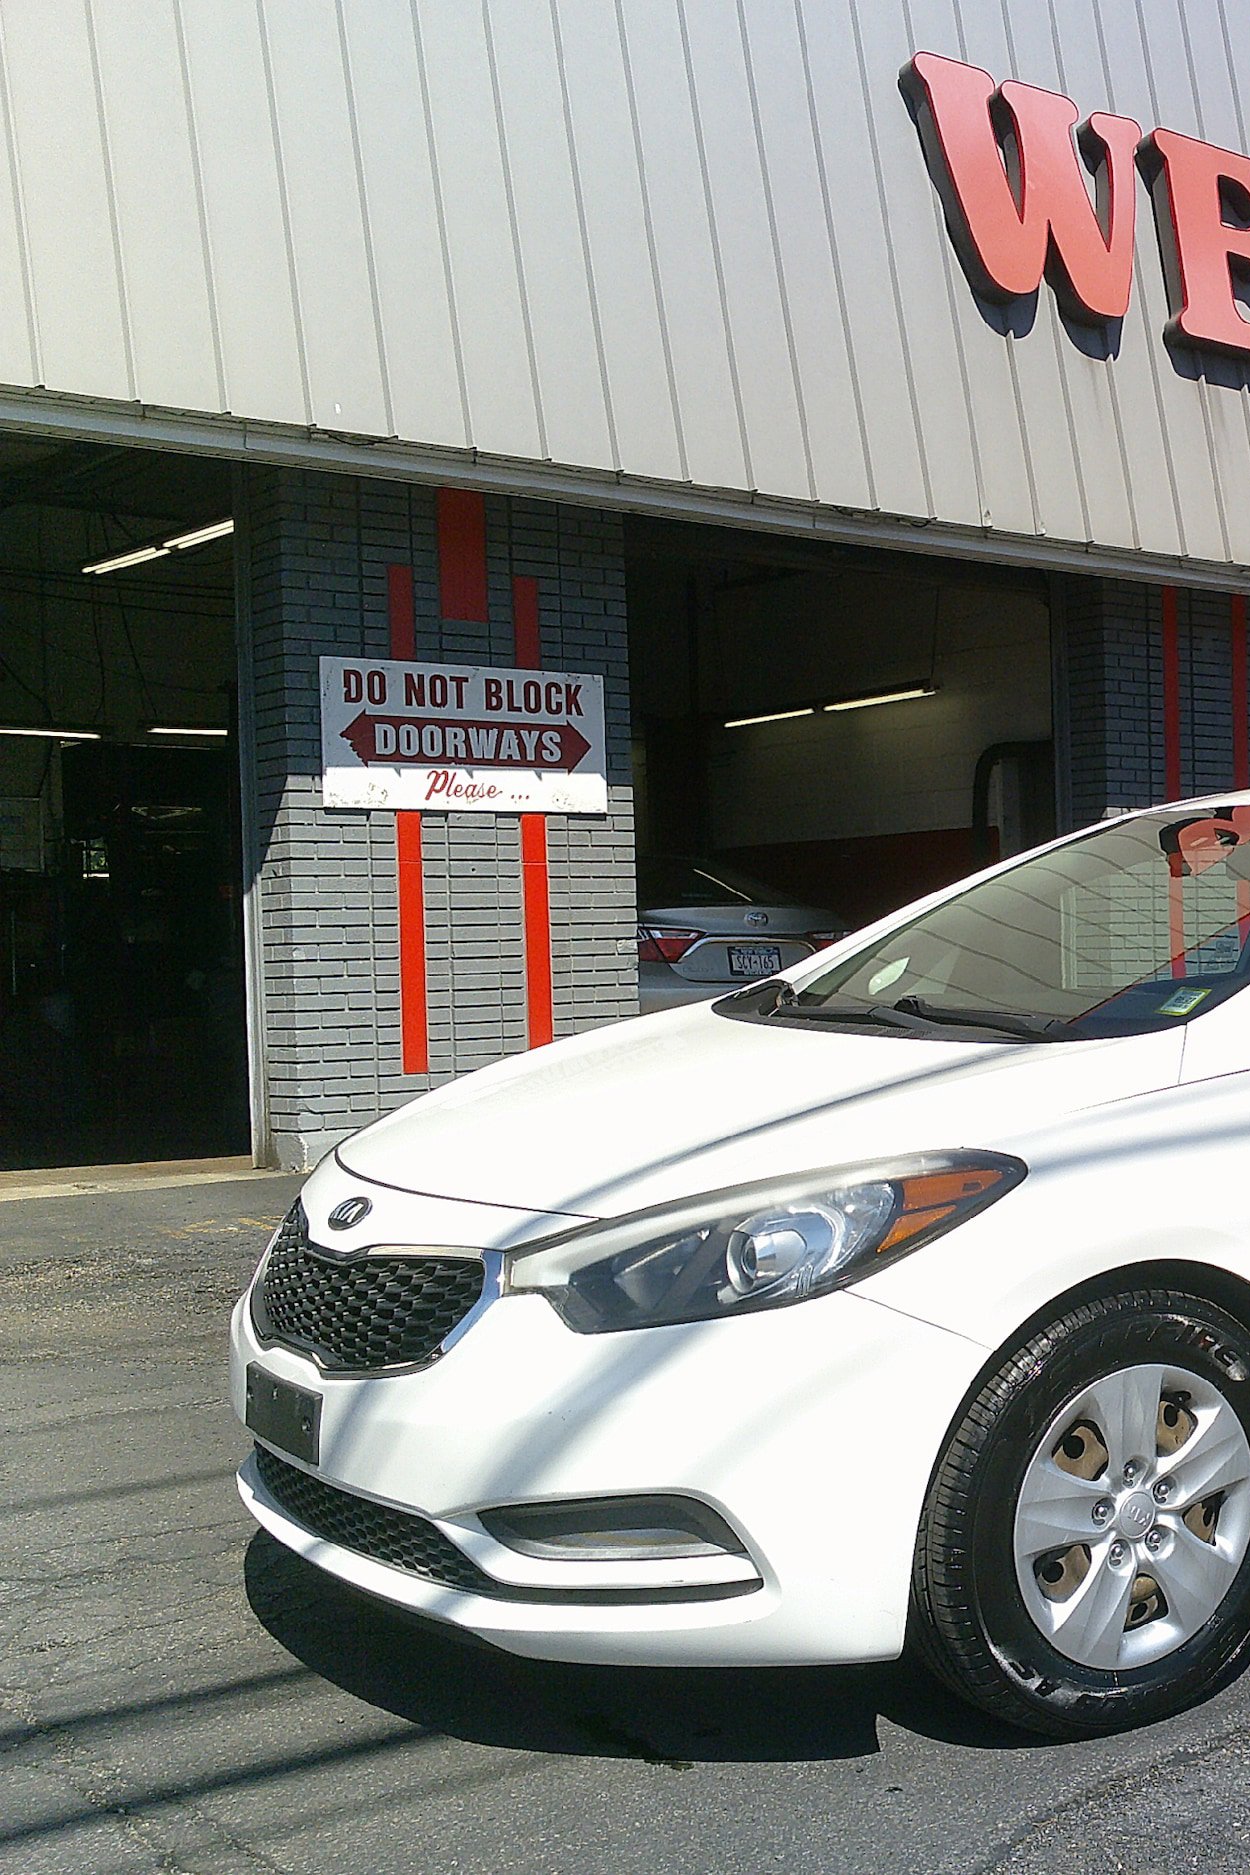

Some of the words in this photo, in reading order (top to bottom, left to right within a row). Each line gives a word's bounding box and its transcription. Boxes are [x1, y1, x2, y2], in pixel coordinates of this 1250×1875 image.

[342, 669, 387, 706] DO
[403, 673, 470, 709] NOT
[484, 678, 585, 717] BLOCK
[373, 722, 563, 762] DOORWAYS
